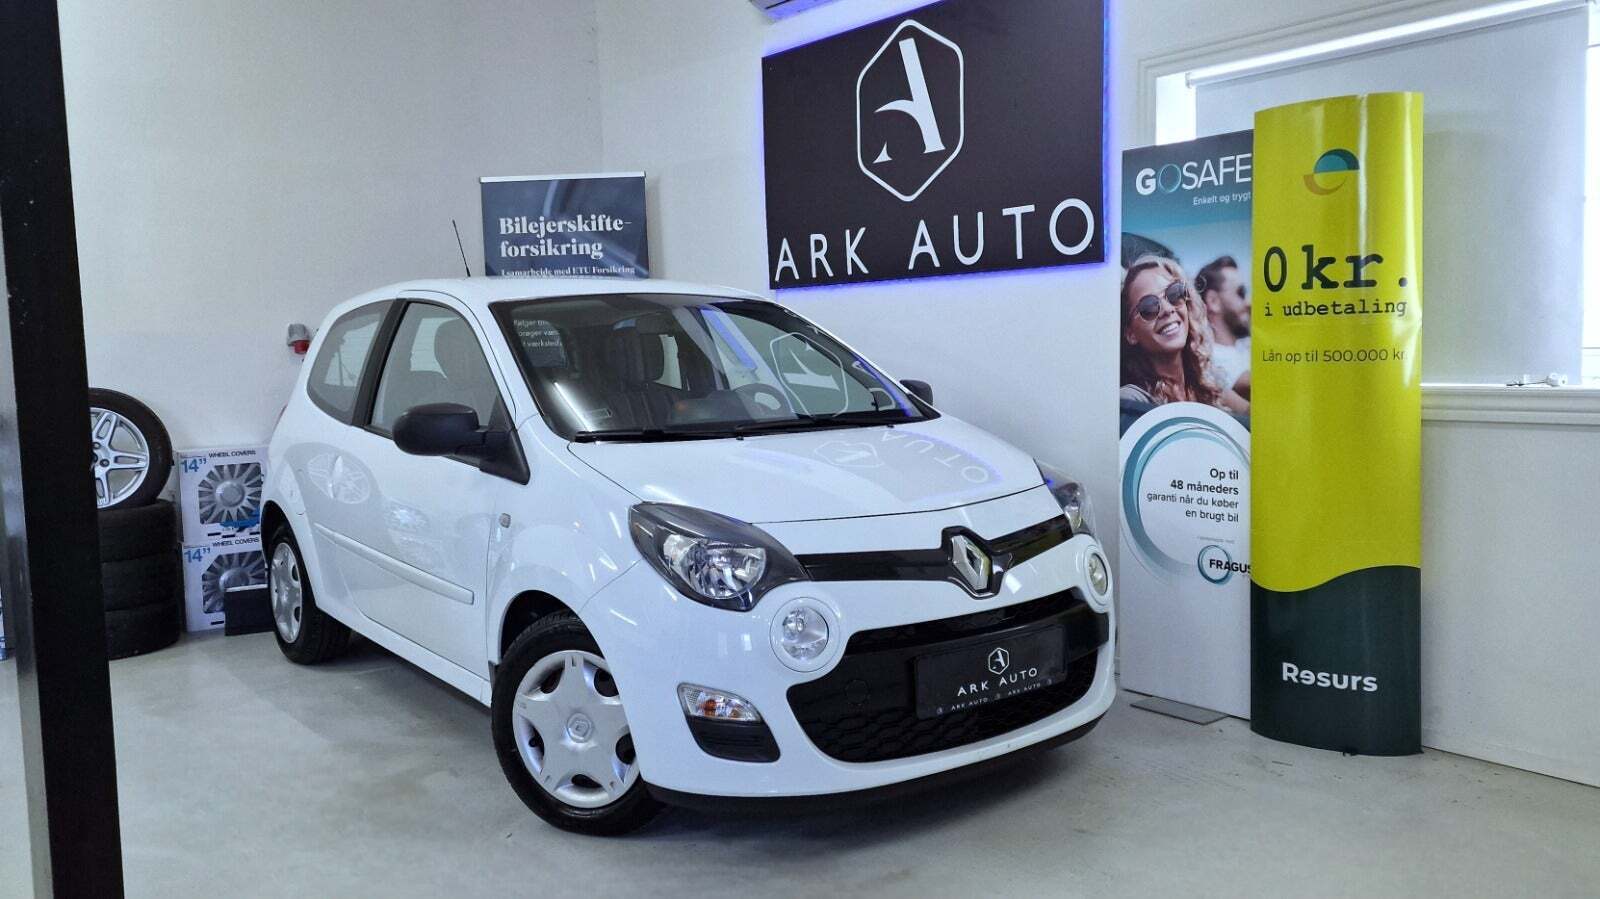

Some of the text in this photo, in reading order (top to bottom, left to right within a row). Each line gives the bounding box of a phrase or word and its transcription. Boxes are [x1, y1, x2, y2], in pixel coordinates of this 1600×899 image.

[1135, 153, 1252, 196] GOSAFE
[1193, 192, 1252, 206] Enkelt og trygt
[499, 214, 632, 239] Bilejerskifte-
[500, 238, 604, 259] forsikring
[774, 198, 1095, 282] ARK AUTO
[553, 267, 571, 275] med
[572, 266, 591, 274] ETU
[592, 265, 636, 274] Forsikring
[1263, 244, 1408, 293] 0 kr.
[1264, 299, 1408, 317] i udbetaling
[1262, 350, 1283, 362] Lån
[1285, 353, 1301, 364] op
[1305, 350, 1319, 362] til
[1323, 349, 1389, 362] 500.000
[1210, 468, 1239, 480] Op til
[1171, 479, 1239, 496] 48 måneders
[1147, 492, 1239, 509] garanti når du køber
[1185, 510, 1239, 523] en brugt bil
[234, 537, 260, 545] COVERS
[957, 667, 1038, 697] ARK AUTO
[1281, 661, 1378, 692] Resurs
[951, 703, 966, 711] ARK
[968, 697, 989, 706] AUTO
[1023, 682, 1041, 691] AUTO
